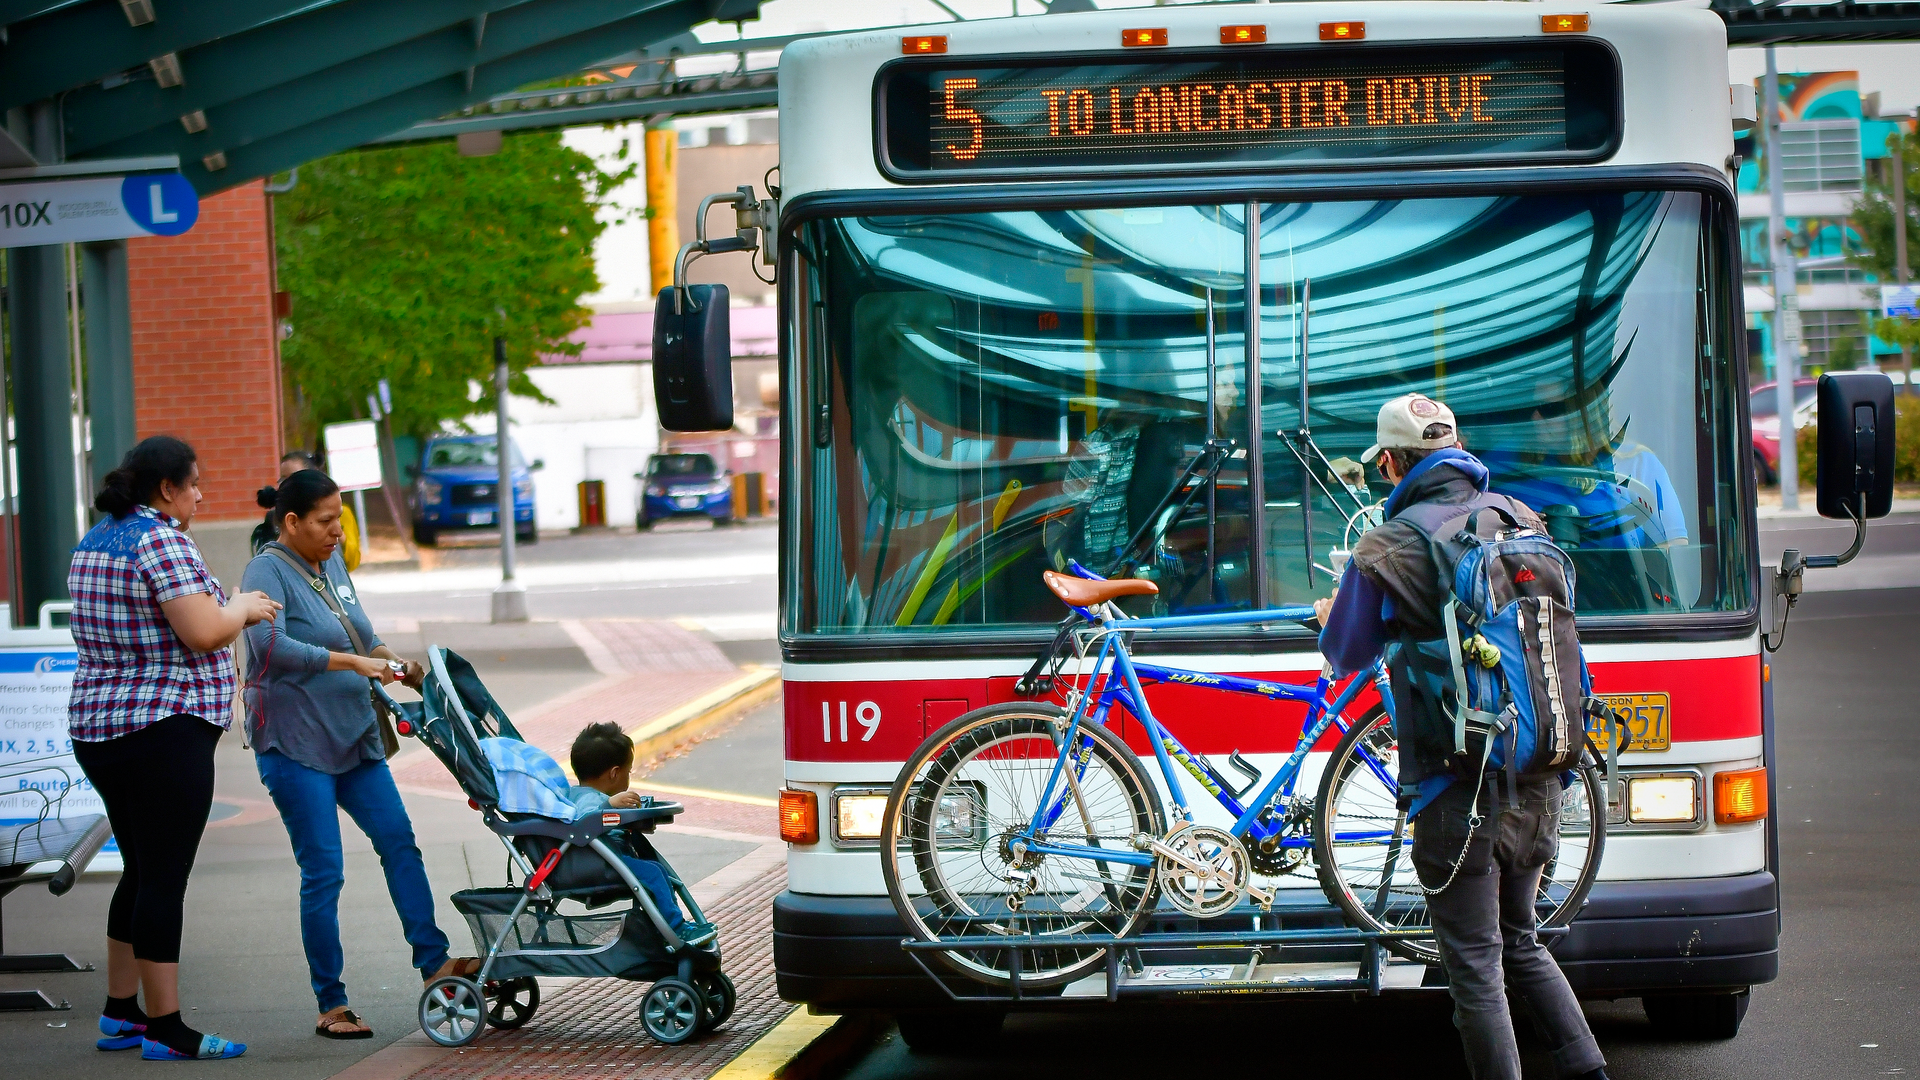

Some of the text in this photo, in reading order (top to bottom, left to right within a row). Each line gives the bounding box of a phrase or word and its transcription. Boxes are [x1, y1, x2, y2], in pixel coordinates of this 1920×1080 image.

[1041, 75, 1494, 136] TO LANCASTER DRIVE
[944, 78, 983, 160] 5
[149, 184, 178, 224] L
[0, 201, 52, 229] 10X
[0, 684, 37, 693] ffective
[1604, 697, 1633, 705] EGON
[4, 718, 55, 731] Changes
[822, 701, 882, 743] 119
[26, 740, 40, 755] 2,
[46, 740, 59, 755] 5,
[1162, 738, 1222, 798] MAGNA
[19, 778, 69, 791] Route
[22, 796, 38, 808] be
